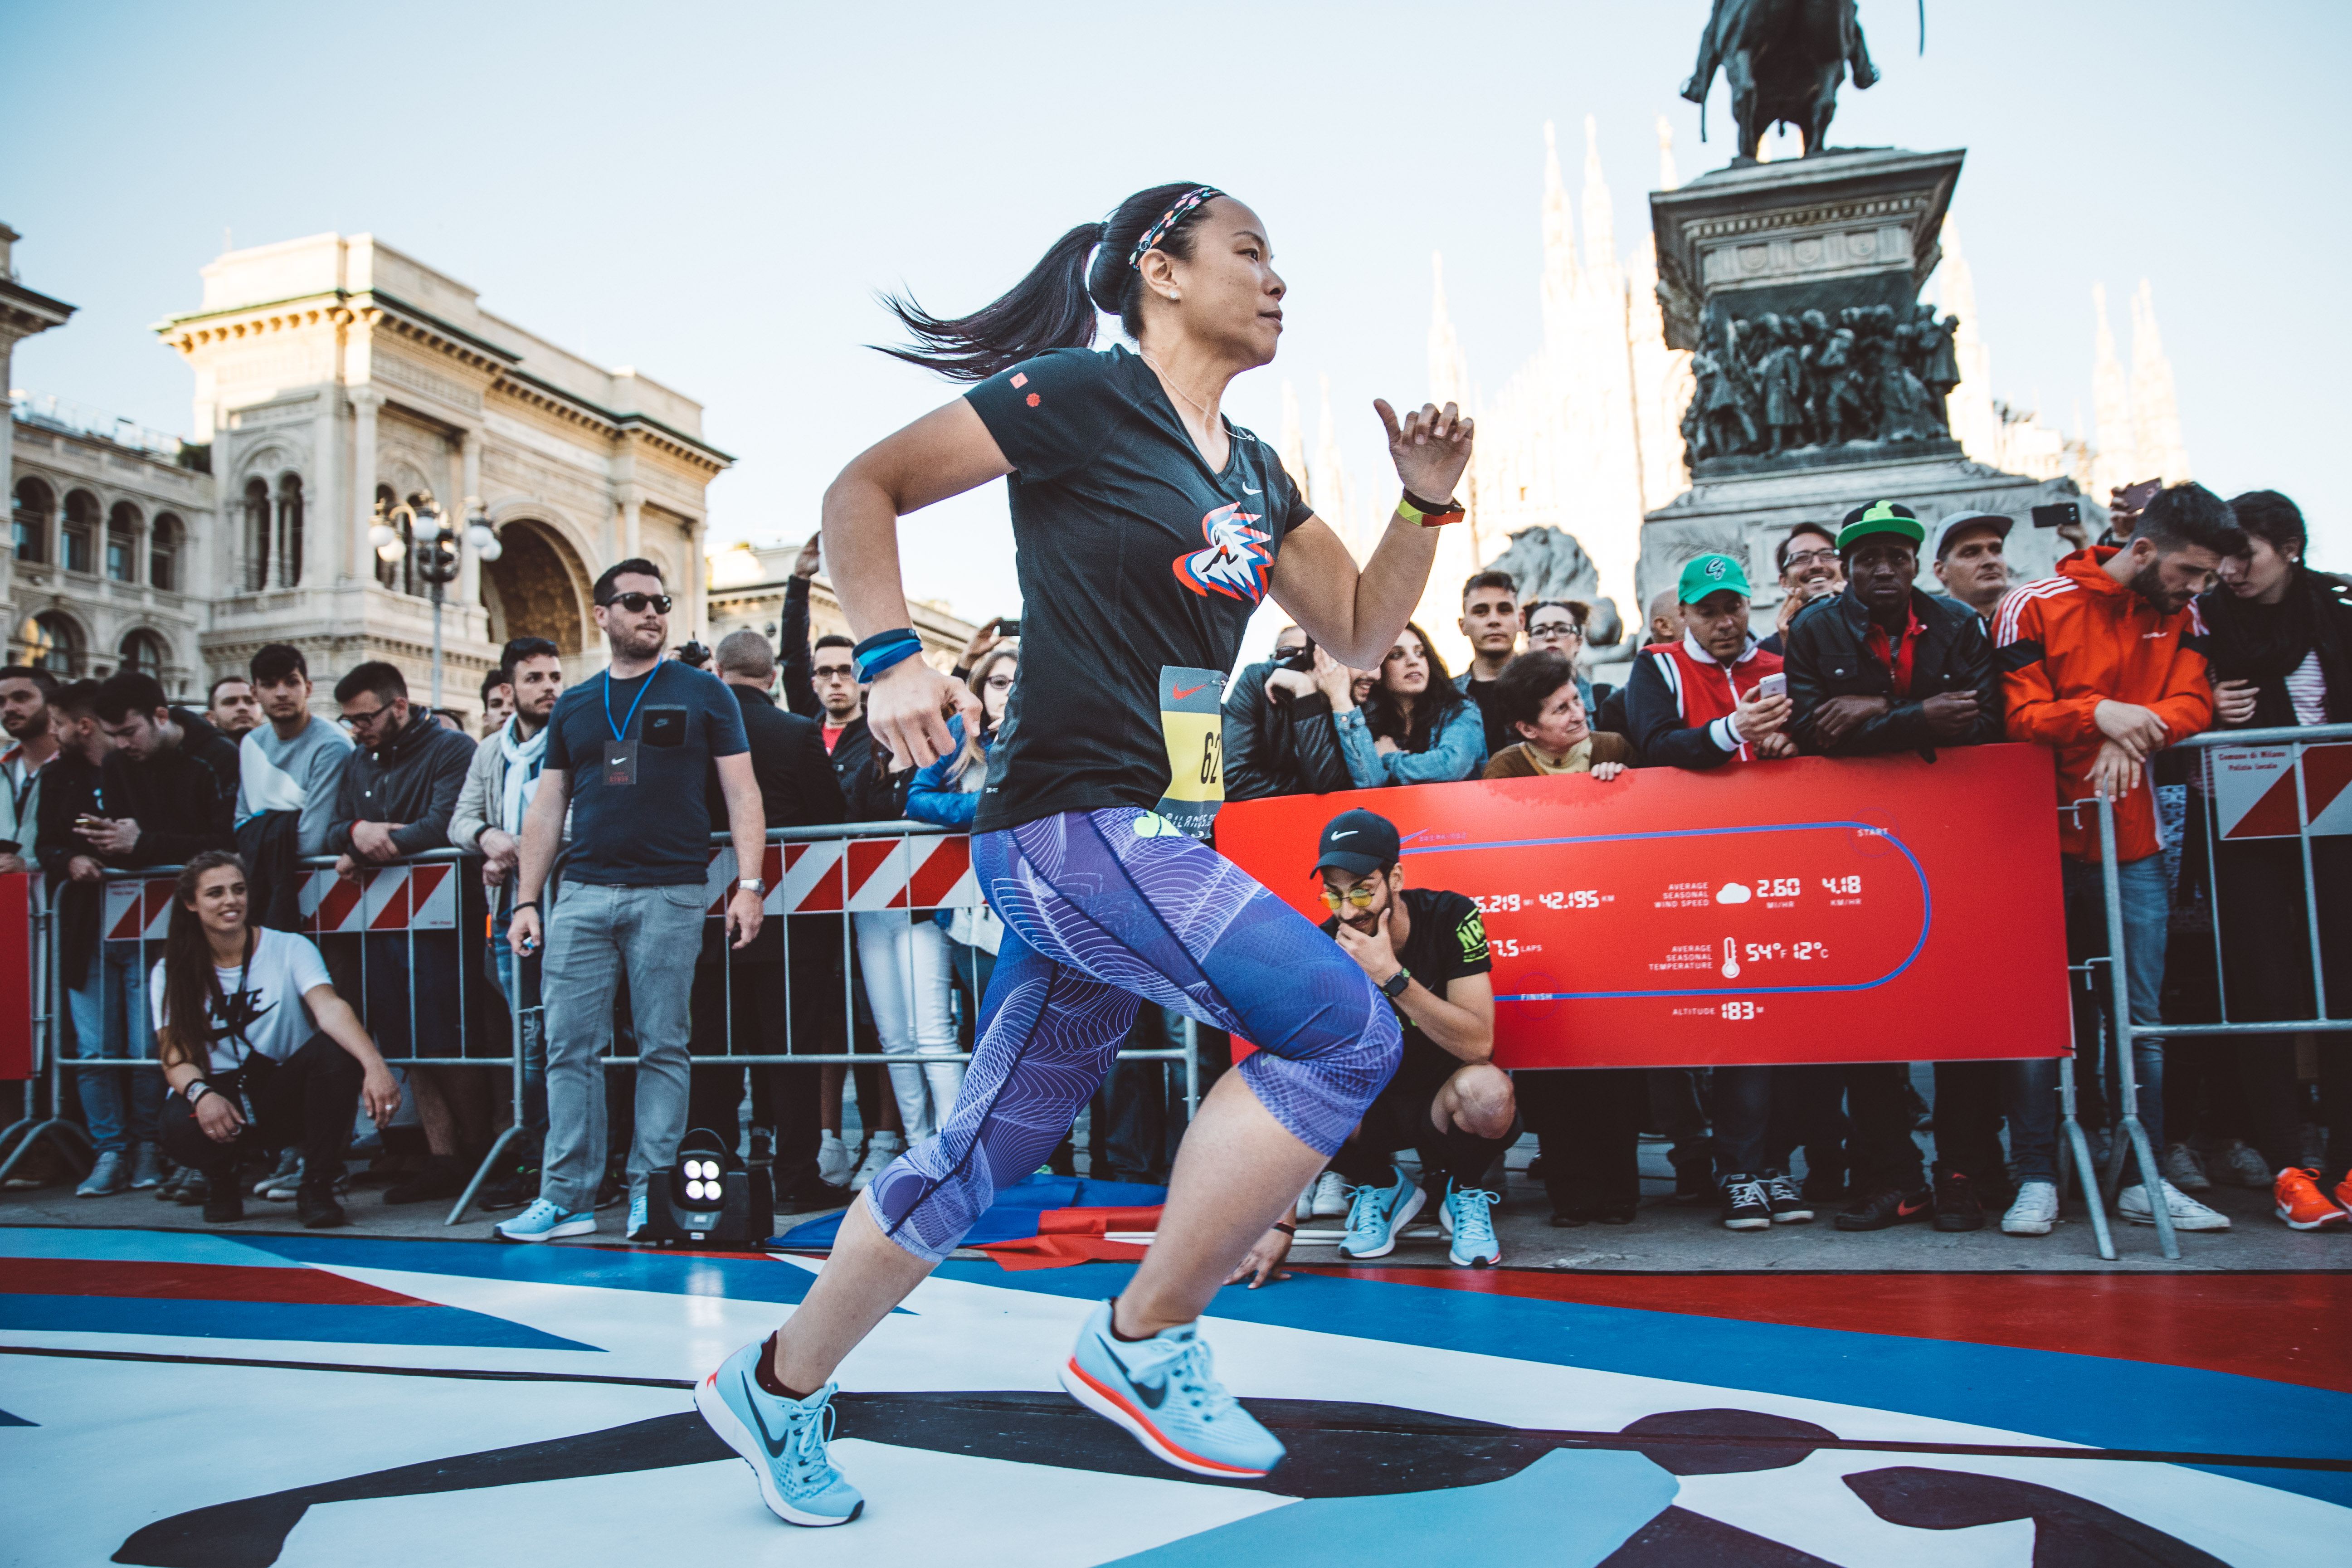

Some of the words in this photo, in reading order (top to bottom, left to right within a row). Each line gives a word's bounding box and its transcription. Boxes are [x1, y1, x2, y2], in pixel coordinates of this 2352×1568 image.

[1857, 828, 1889, 837] START
[1668, 882, 1709, 891] AVERAGE
[1757, 878, 1801, 898] 2.60
[1822, 875, 1861, 894] 4.18
[1539, 890, 1599, 910] 42.195
[1662, 891, 1709, 900] SEASONAL
[1654, 900, 1678, 908] WIND
[1680, 899, 1710, 907] SPEED
[1520, 944, 1543, 953] LAPS
[1671, 945, 1712, 953] AVERAGE
[1665, 954, 1713, 962] SEASONAL
[1648, 962, 1713, 971] TEMPERATURE
[1672, 1008, 1716, 1016] ALTITUDE
[1721, 1001, 1754, 1020] 183
